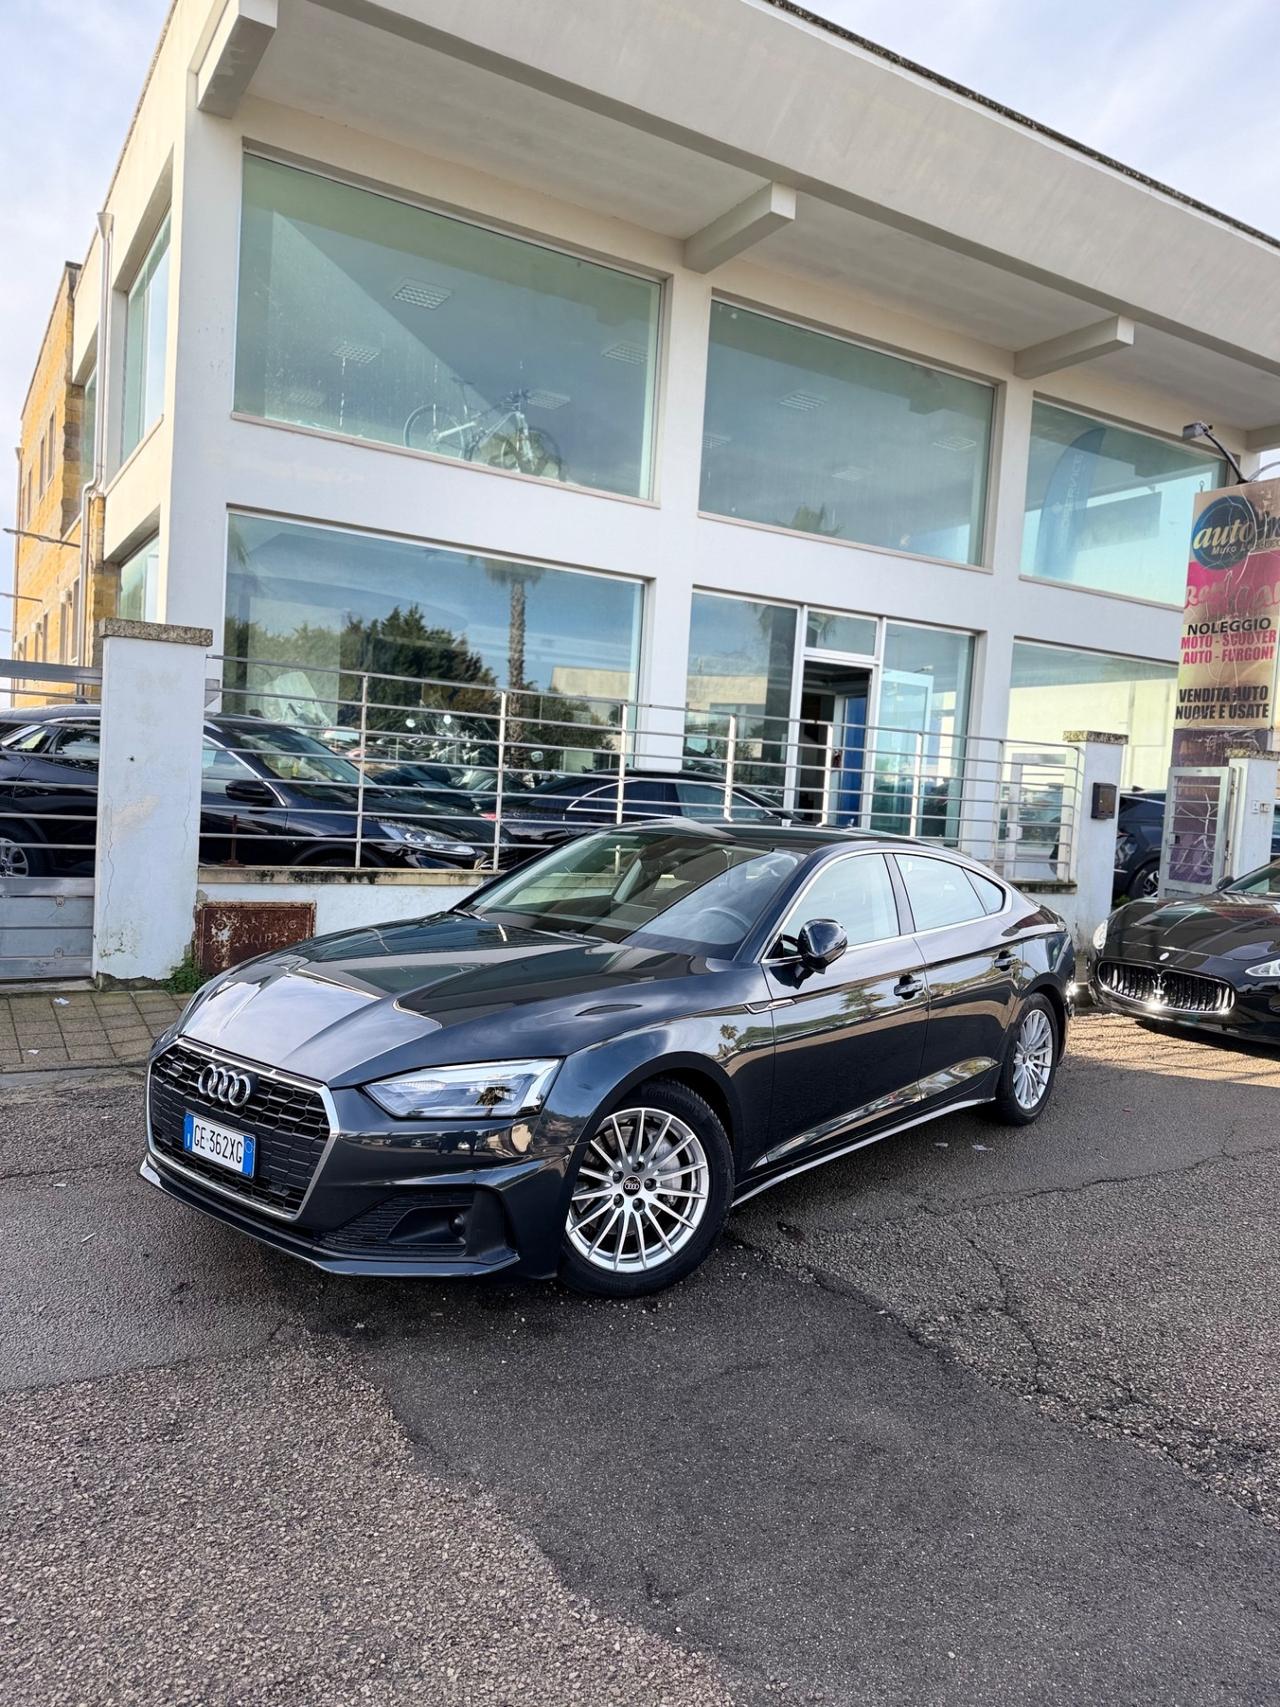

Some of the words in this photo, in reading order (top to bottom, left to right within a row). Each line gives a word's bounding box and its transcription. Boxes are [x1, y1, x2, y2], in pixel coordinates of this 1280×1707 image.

[1187, 618, 1271, 635] NOLEGGIO
[1181, 635, 1213, 649] MOTO
[1222, 630, 1277, 646] SCOOTER
[1183, 650, 1213, 664] AUTO
[1222, 646, 1274, 662] FURGONI
[1179, 687, 1231, 703] VENDITA
[1233, 685, 1269, 702] AUTO
[1175, 704, 1216, 719] NUOVE
[1218, 704, 1227, 719] E
[1228, 703, 1269, 719] USATE
